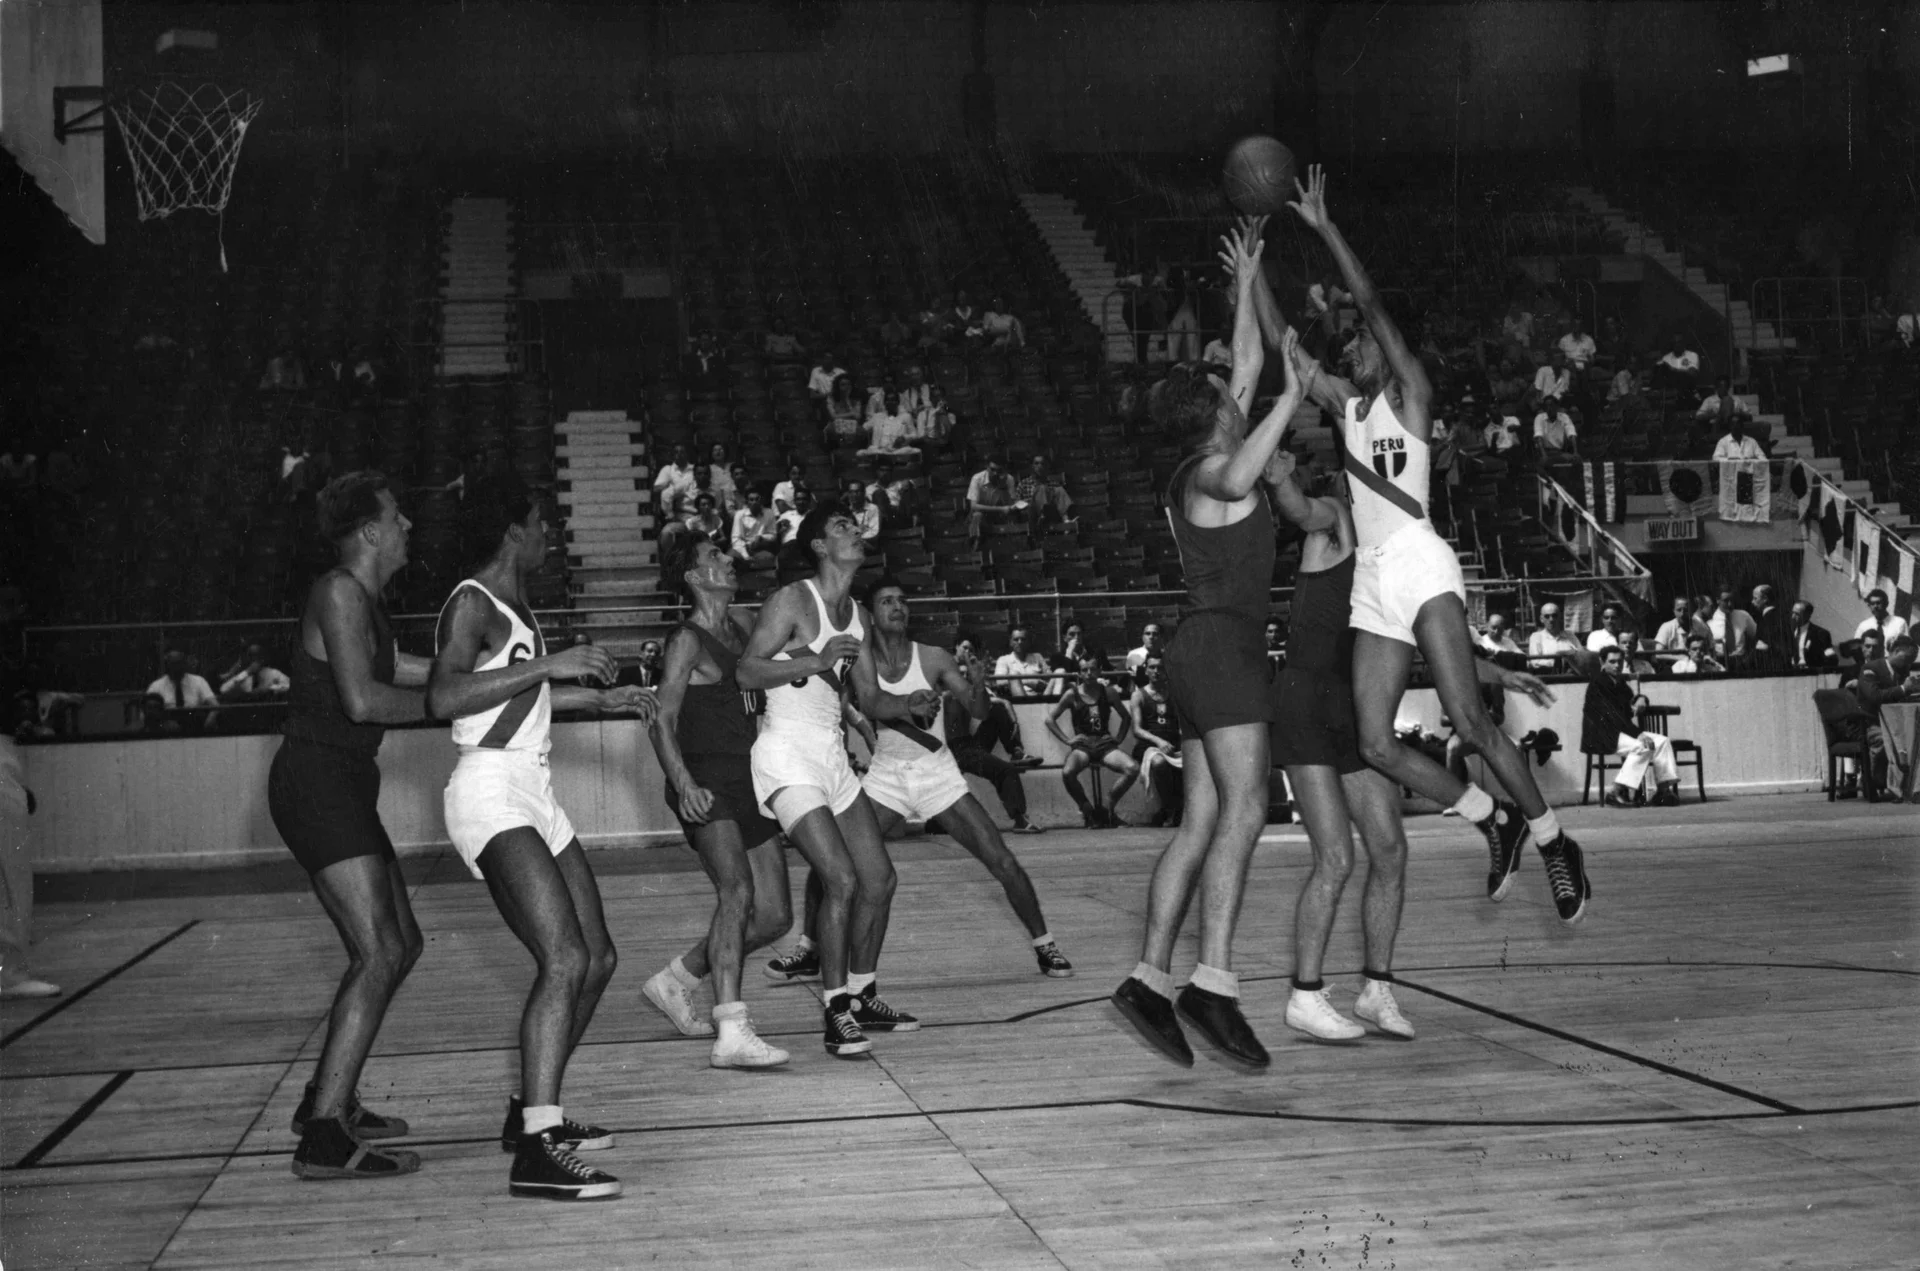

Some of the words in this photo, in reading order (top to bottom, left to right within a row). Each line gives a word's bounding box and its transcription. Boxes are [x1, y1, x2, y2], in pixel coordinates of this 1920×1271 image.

[1372, 437, 1405, 454] PERU
[1648, 521, 1670, 540] WAY
[1671, 520, 1696, 539] OUT
